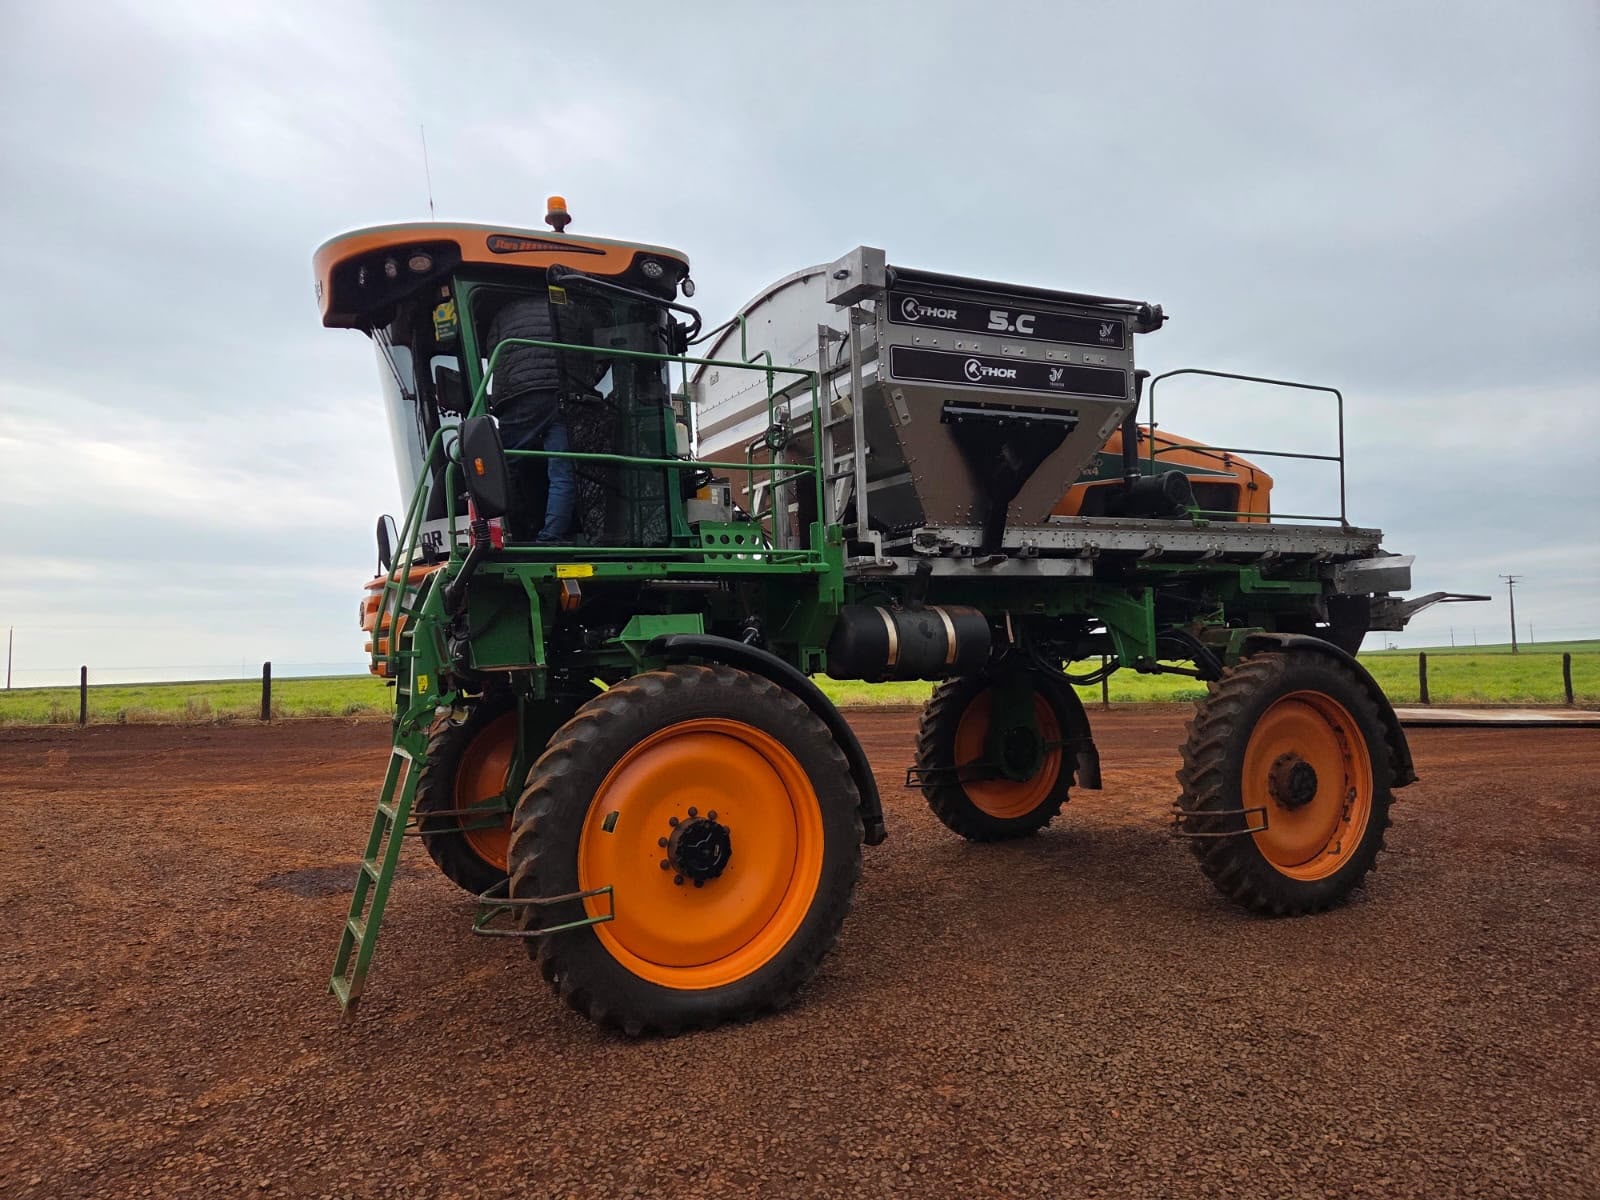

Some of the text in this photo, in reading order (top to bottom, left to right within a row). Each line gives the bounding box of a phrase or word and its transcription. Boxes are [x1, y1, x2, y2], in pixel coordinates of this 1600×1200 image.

[917, 305, 957, 320] THOR
[987, 309, 1036, 334] S.C
[979, 366, 1017, 379] THOR
[418, 530, 443, 547] OR
